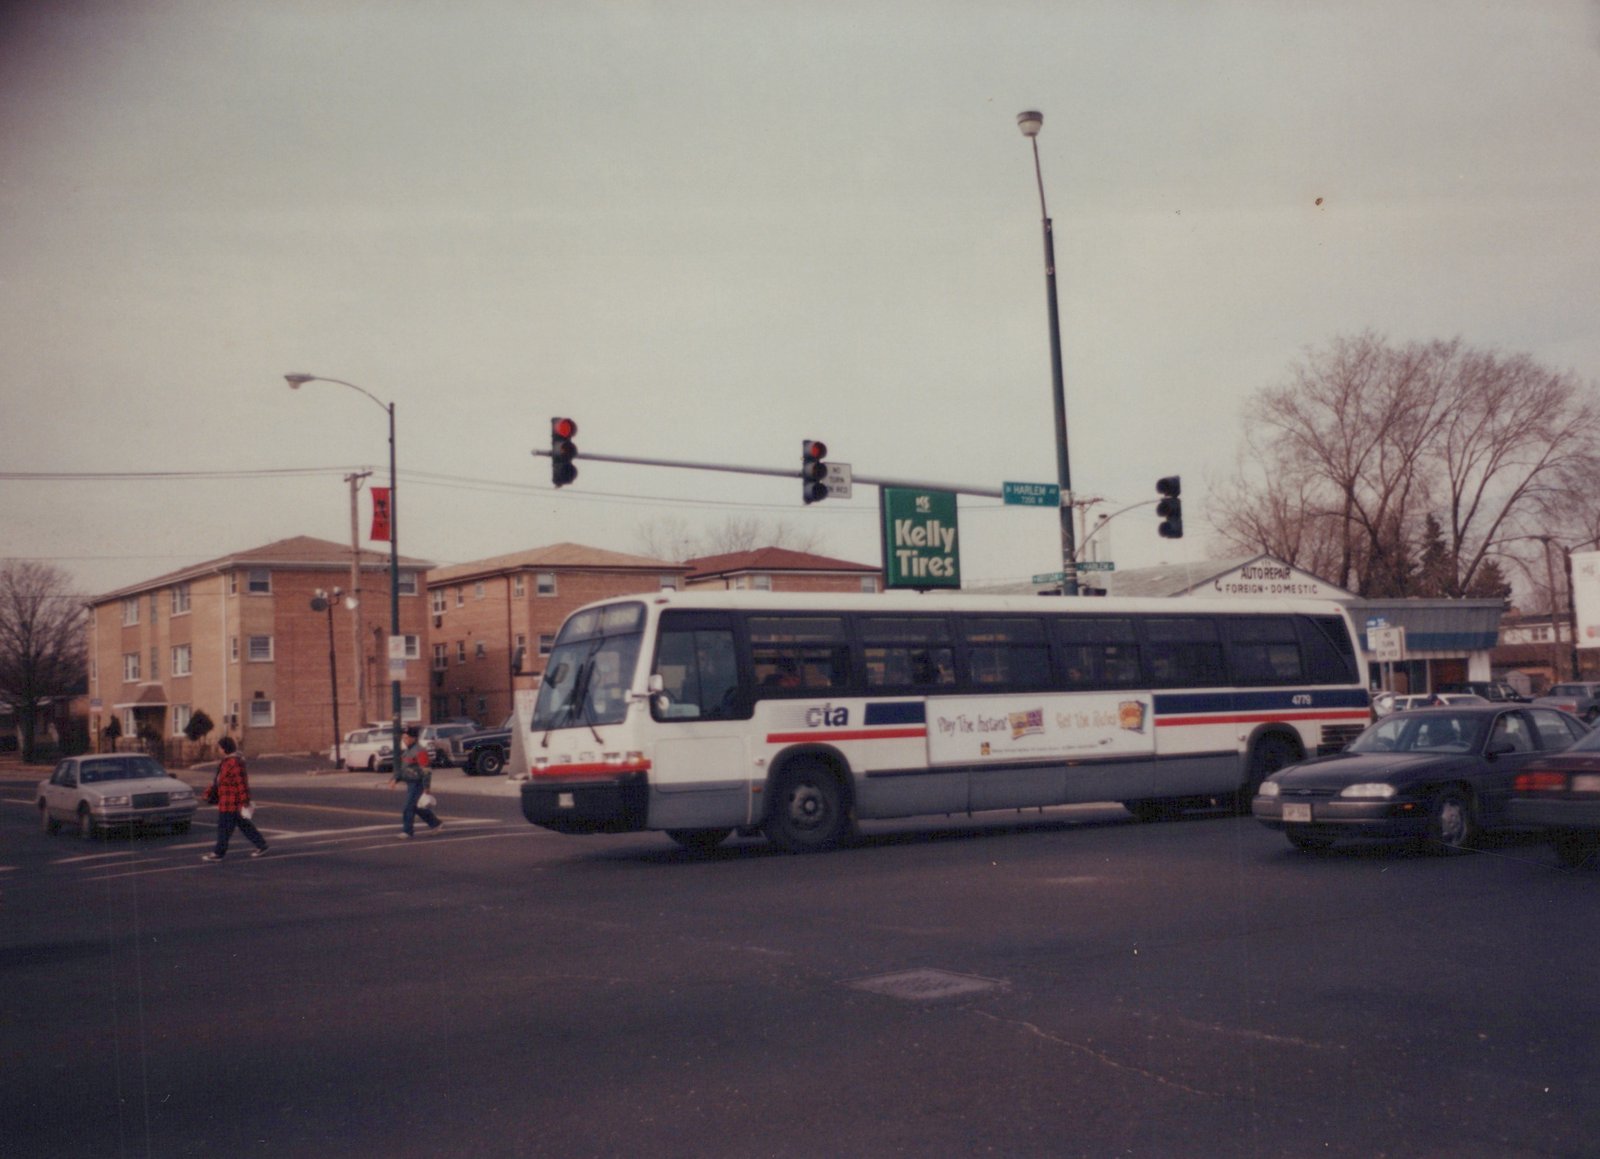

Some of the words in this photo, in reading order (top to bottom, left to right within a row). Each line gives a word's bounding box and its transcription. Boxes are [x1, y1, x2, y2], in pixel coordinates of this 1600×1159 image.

[1013, 484, 1046, 496] HARLEM
[895, 519, 955, 553] Kelly
[896, 550, 954, 577] Tires
[1225, 584, 1263, 593] FOREIGN
[1271, 584, 1318, 594] DOMESTIC
[805, 703, 849, 727] cta
[937, 716, 956, 737] Play
